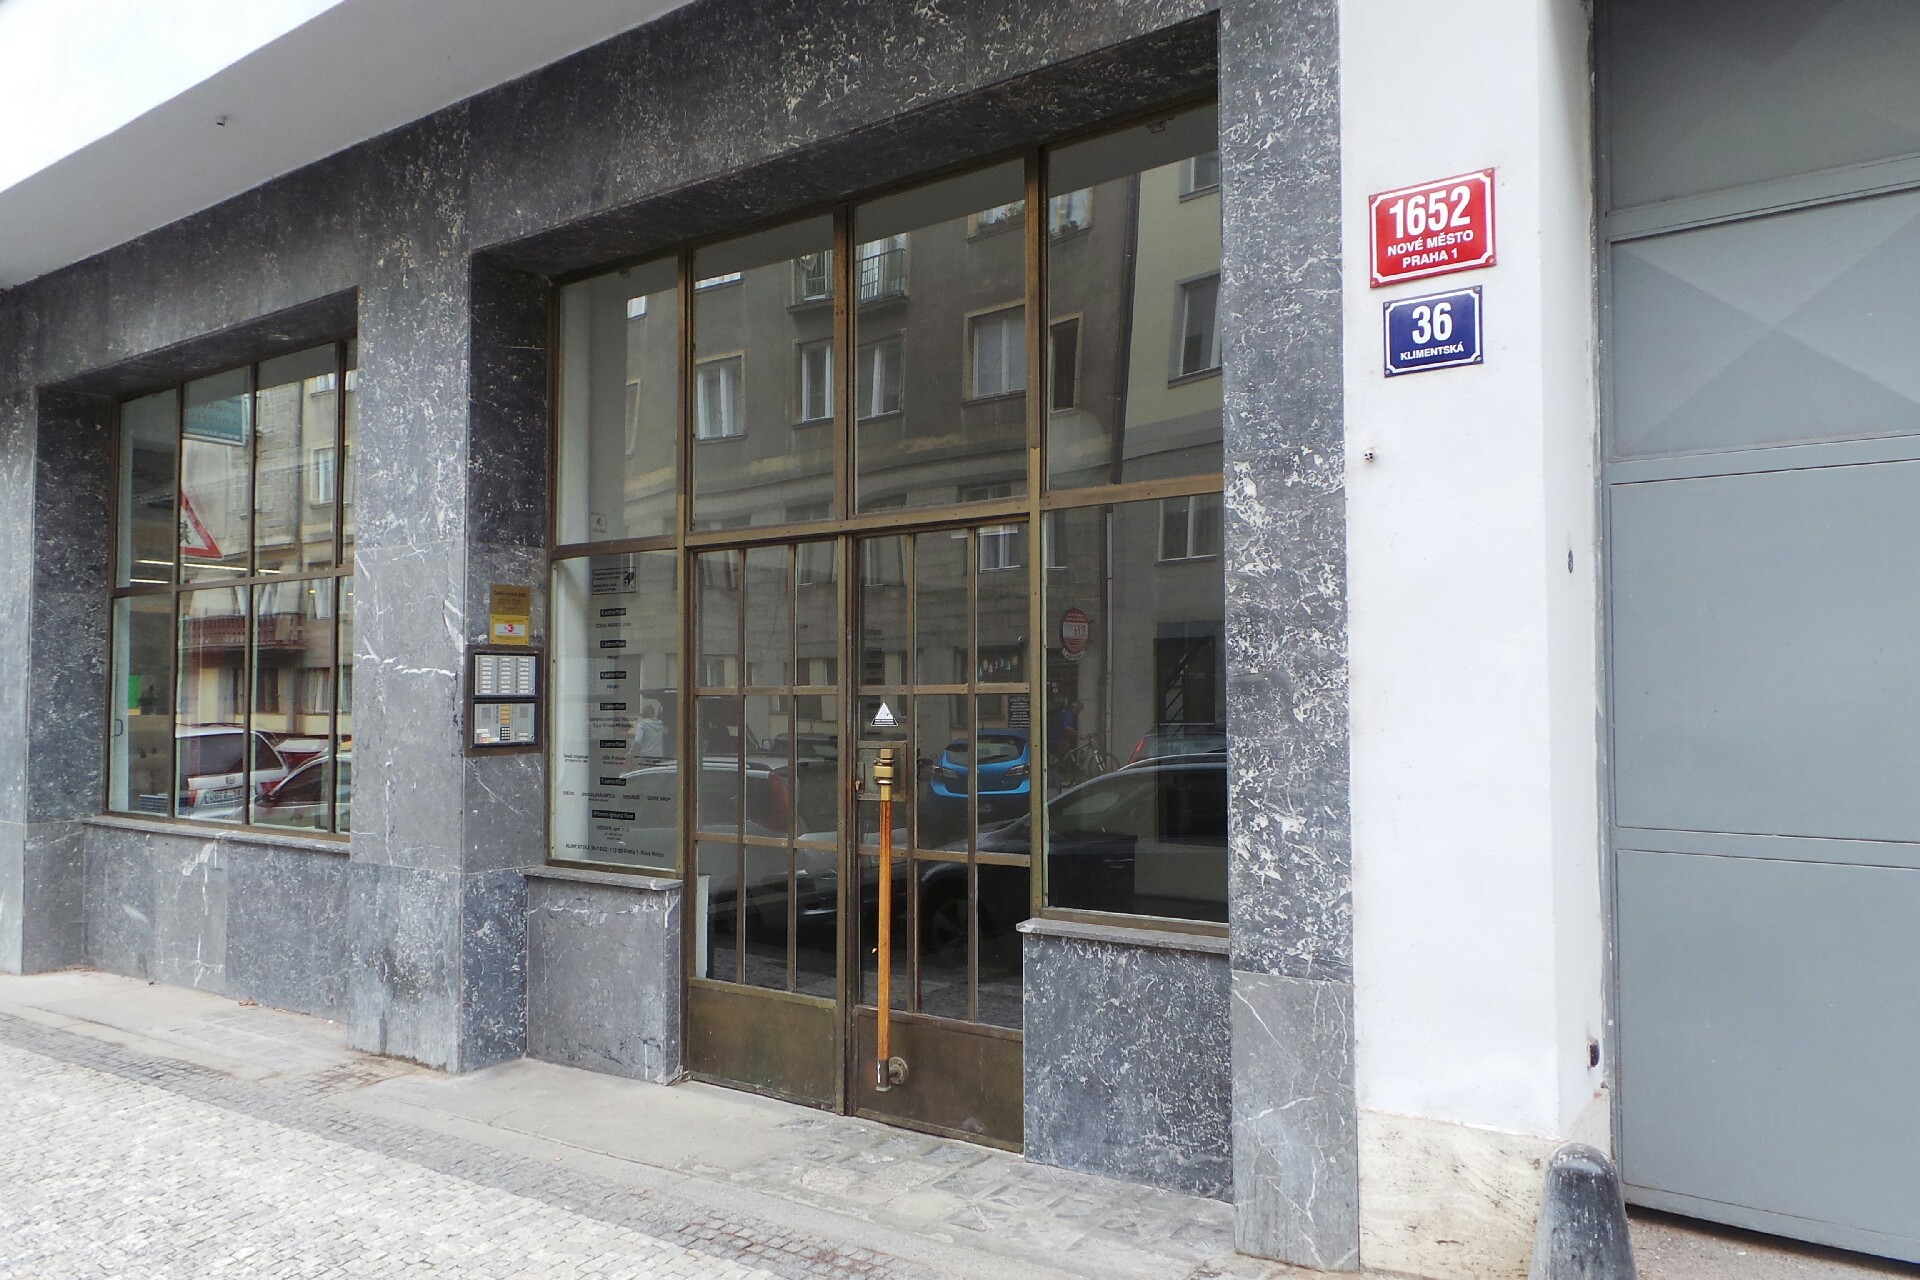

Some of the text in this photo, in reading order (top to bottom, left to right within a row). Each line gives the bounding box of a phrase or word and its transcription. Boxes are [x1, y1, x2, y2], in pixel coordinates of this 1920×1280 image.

[1389, 185, 1471, 239] 1652
[1387, 229, 1474, 256] NOVÉ MĚSTO
[1402, 247, 1459, 269] PRAHA 1
[1412, 302, 1453, 345] 36
[1400, 341, 1465, 361] KLIMENTSKÁ
